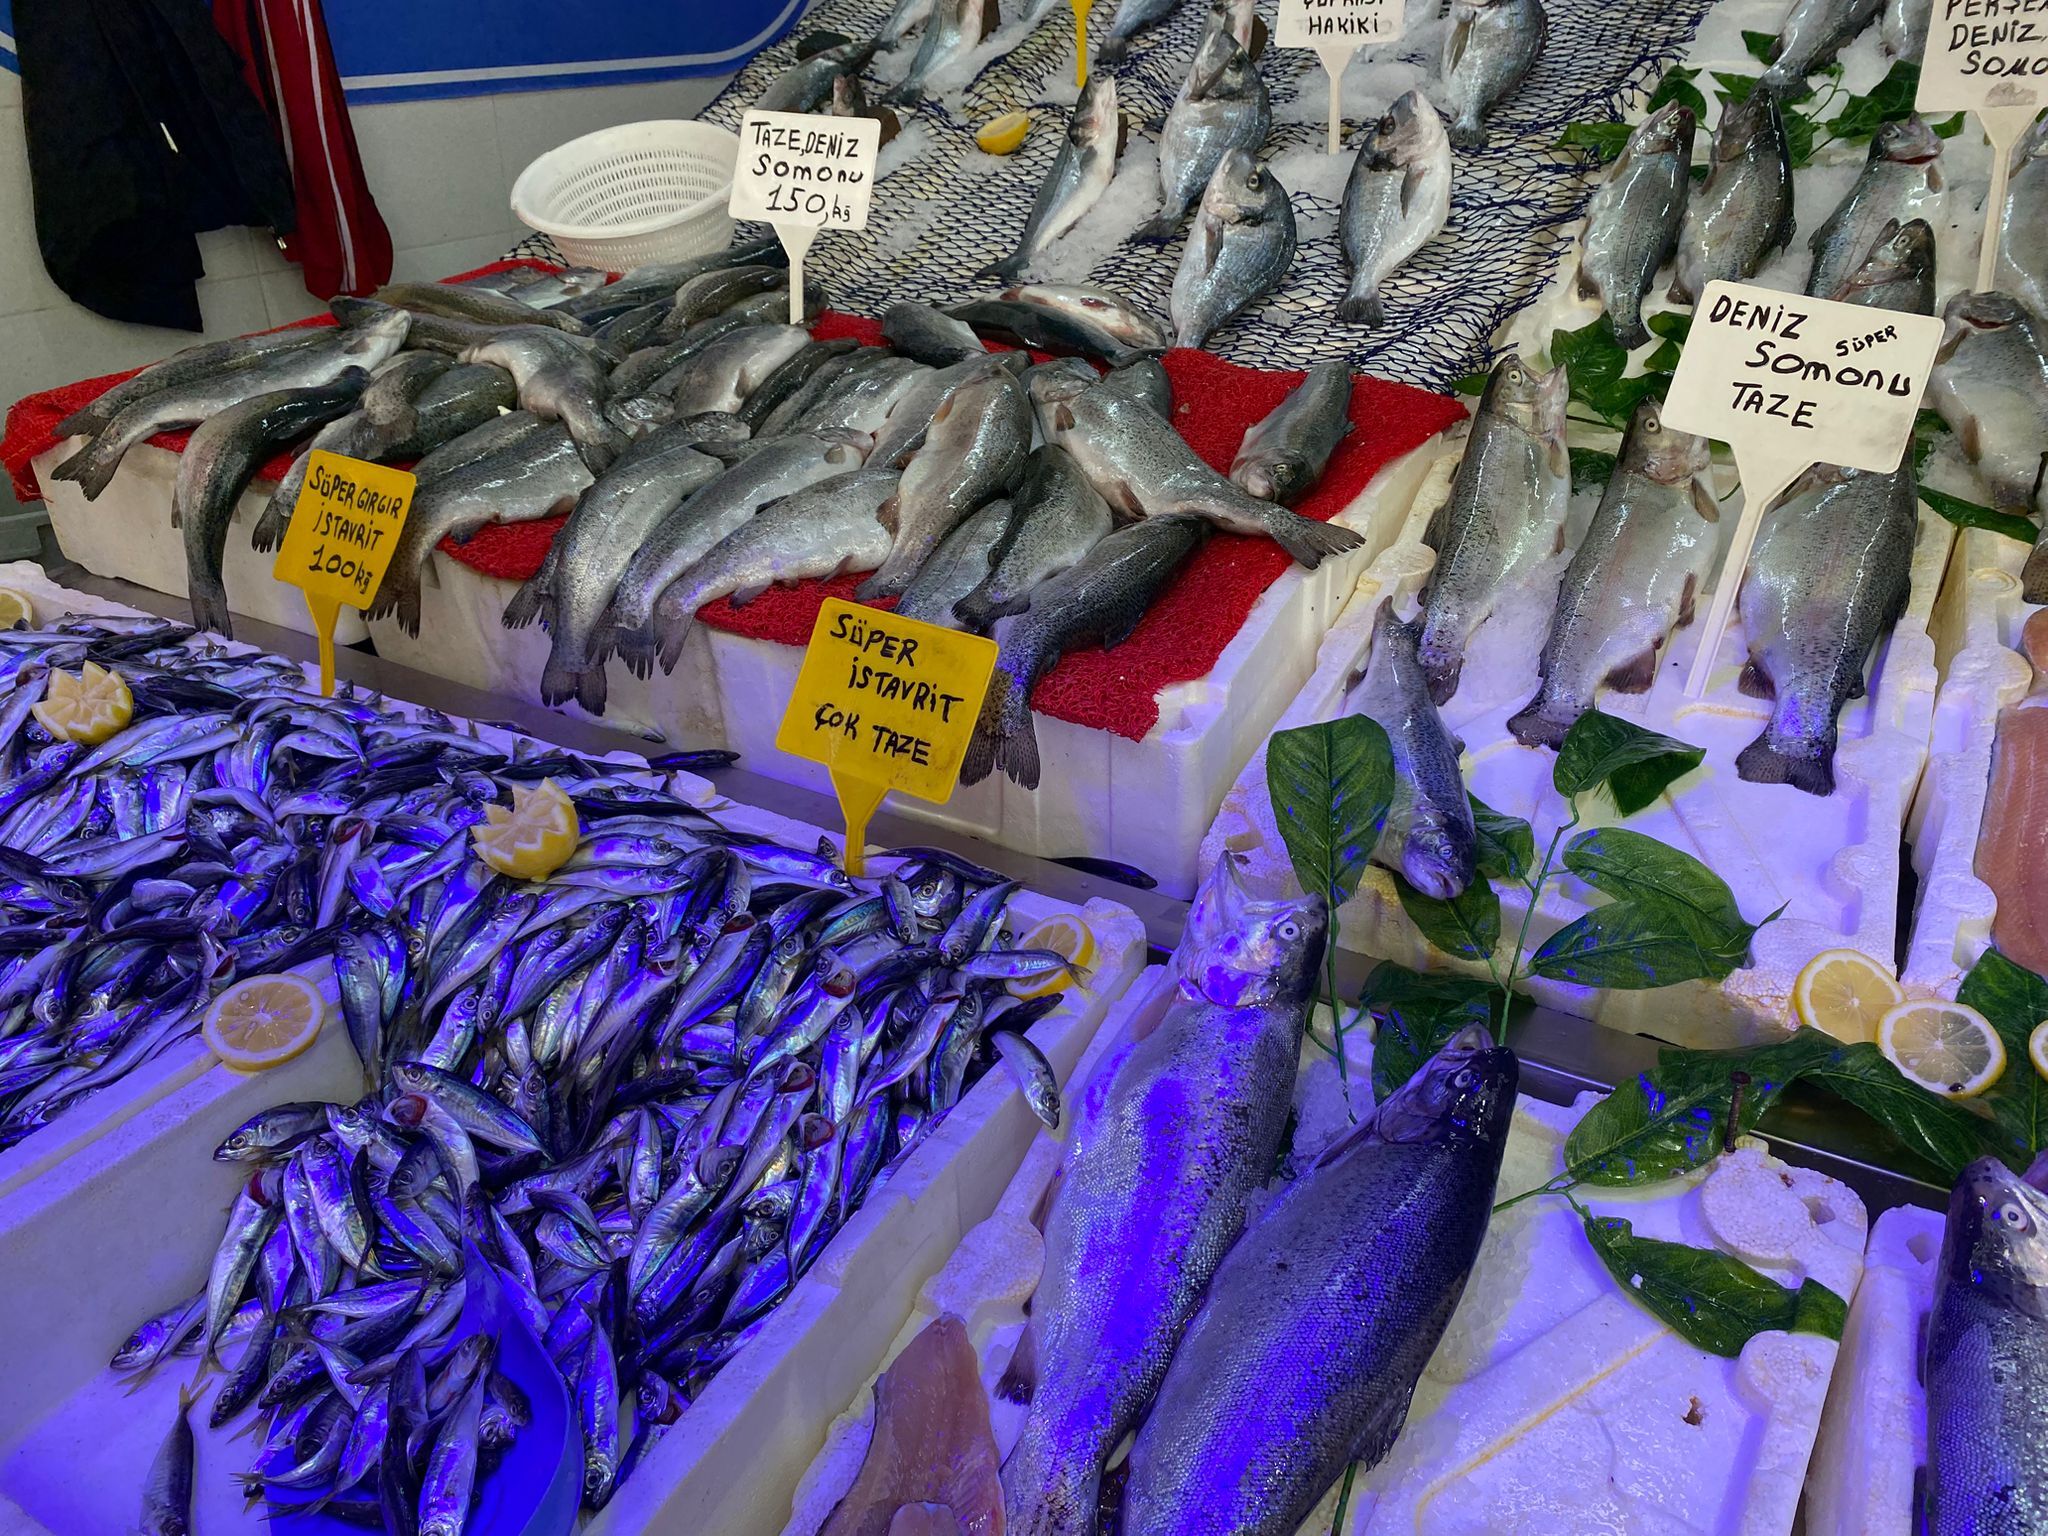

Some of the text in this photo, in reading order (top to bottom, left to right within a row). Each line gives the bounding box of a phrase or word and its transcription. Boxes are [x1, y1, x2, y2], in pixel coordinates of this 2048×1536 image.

[1709, 294, 1808, 340] DENİZ
[1835, 325, 1898, 357] SÜPER
[1732, 382, 1818, 429] TAZE
[312, 502, 384, 551] İSTAVRİT
[830, 613, 919, 667] SÜPER
[848, 656, 965, 723] İSTAVRİT
[814, 702, 932, 767] ÇOK TAZE
